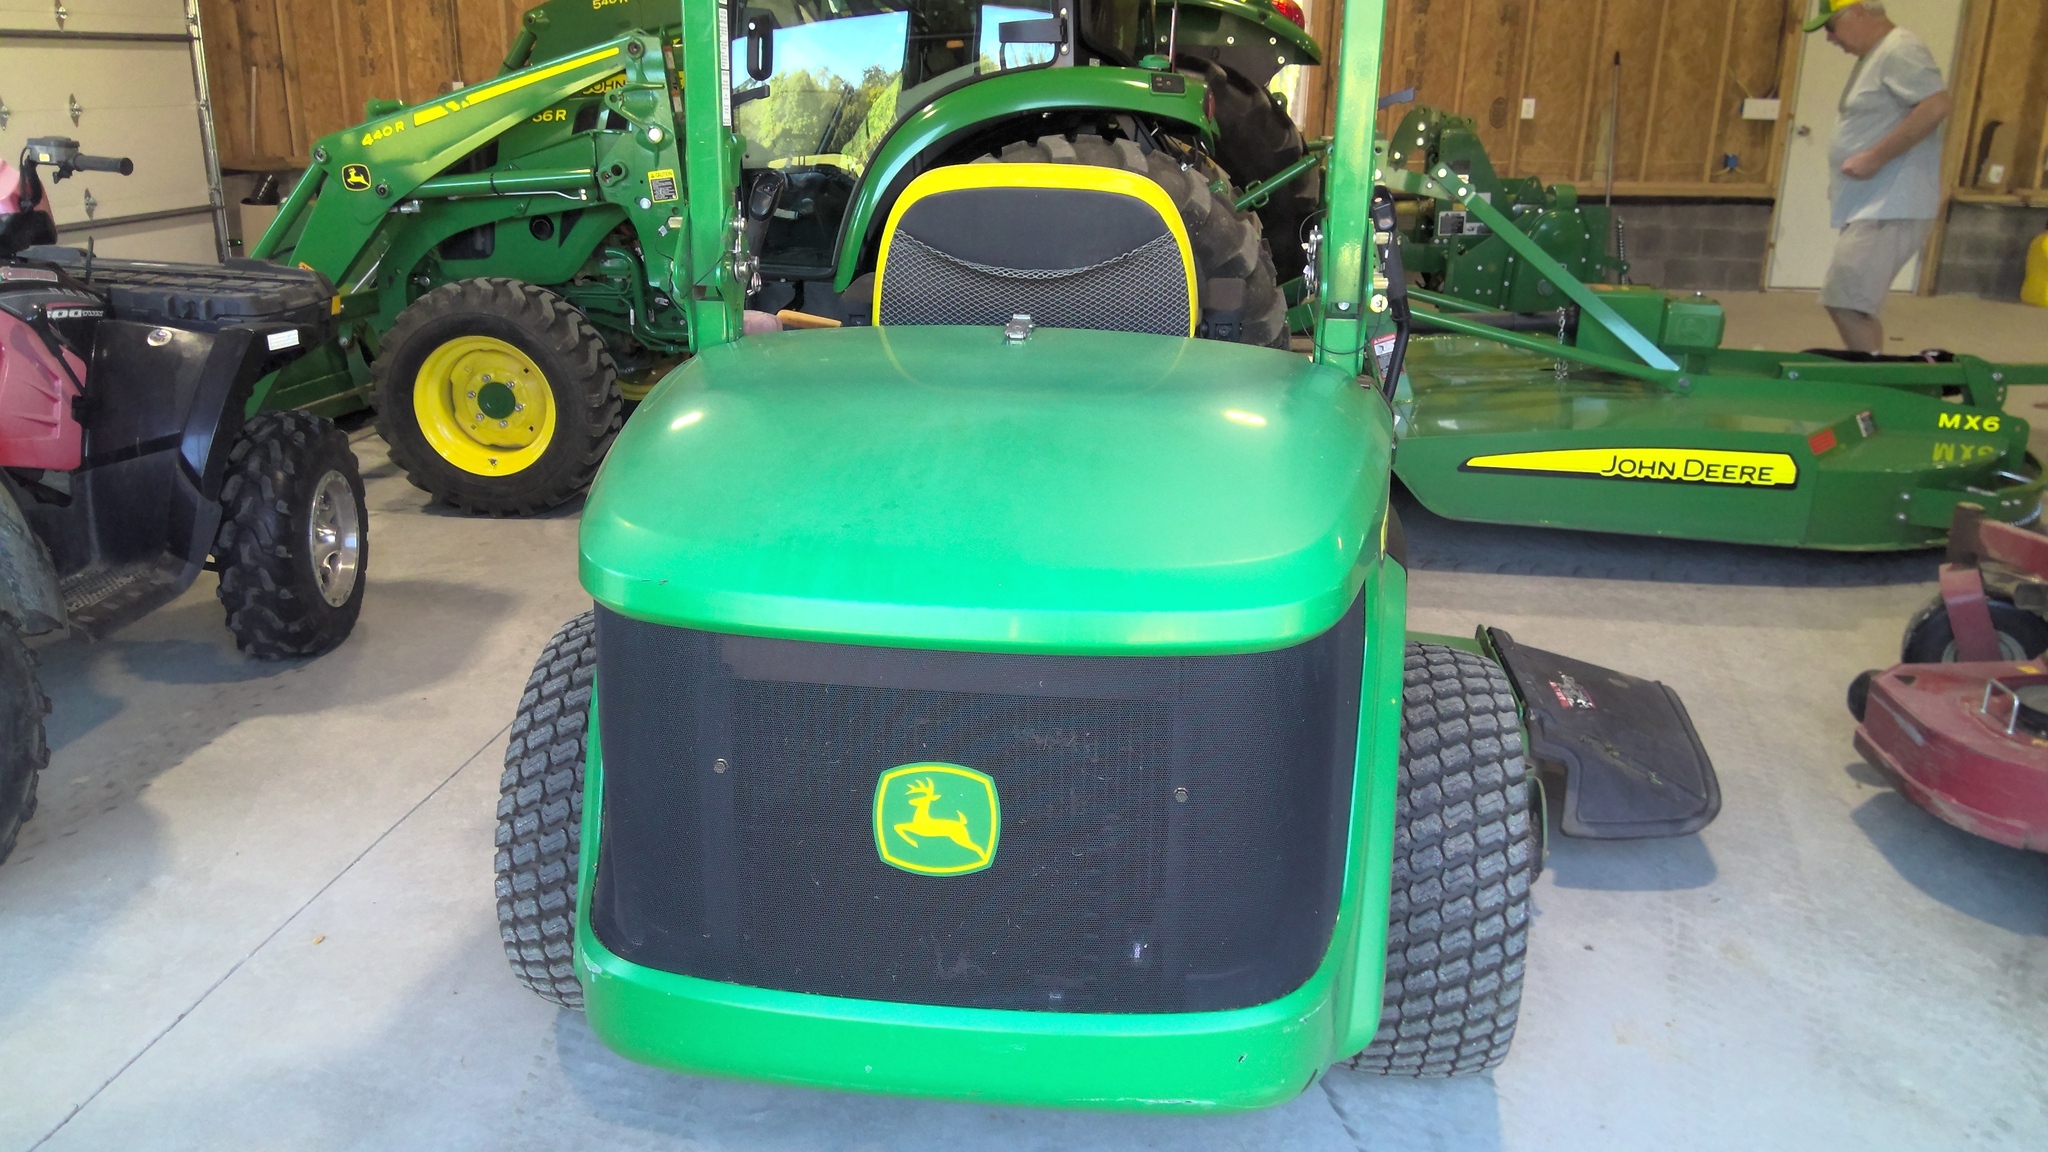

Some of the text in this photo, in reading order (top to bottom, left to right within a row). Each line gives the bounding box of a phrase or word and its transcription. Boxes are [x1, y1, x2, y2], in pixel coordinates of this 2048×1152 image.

[361, 125, 394, 146] 440
[1937, 412, 2000, 432] MX6
[1601, 455, 1775, 482] JOHN DEERE
